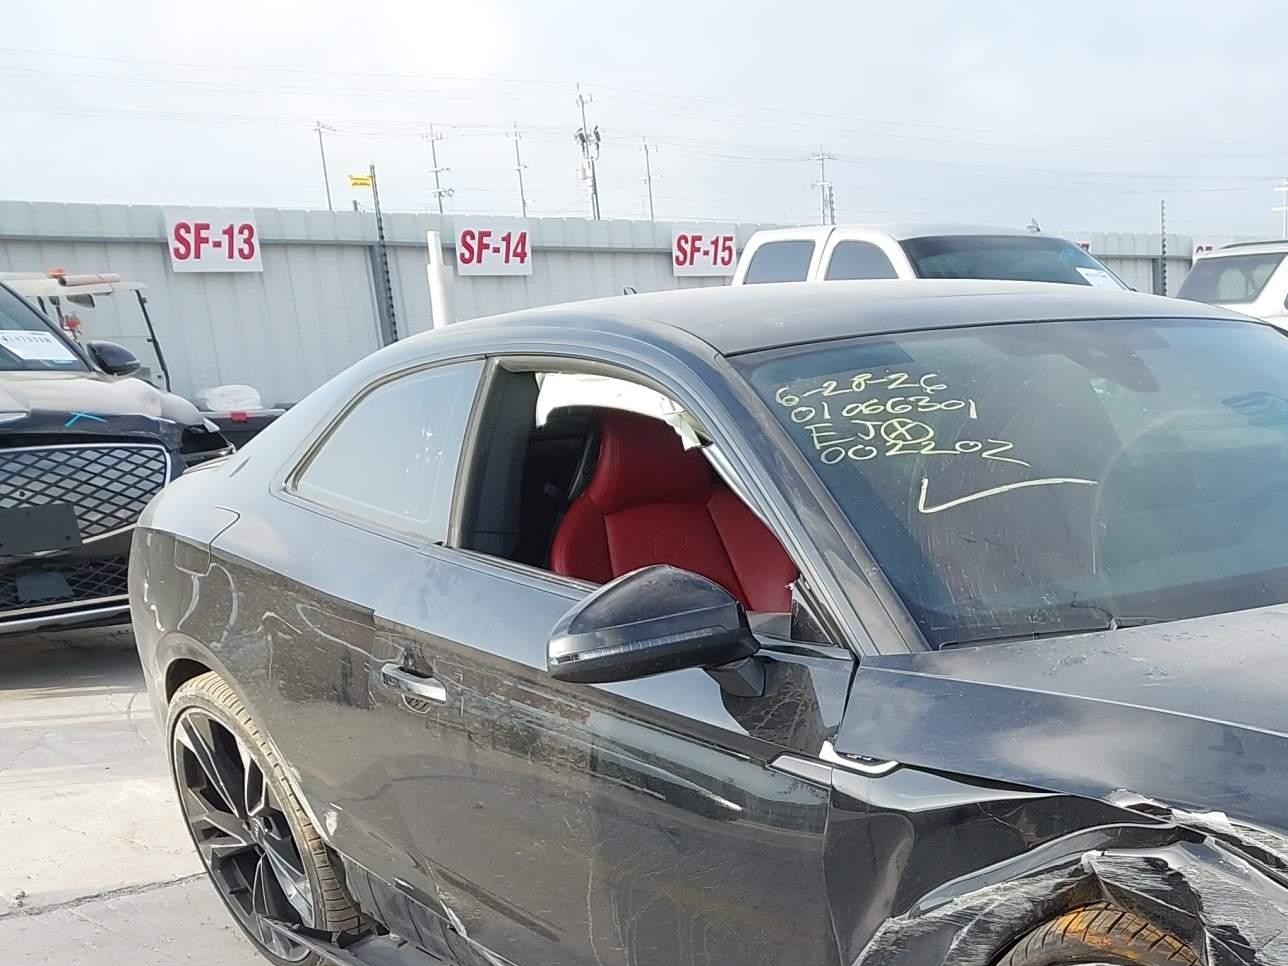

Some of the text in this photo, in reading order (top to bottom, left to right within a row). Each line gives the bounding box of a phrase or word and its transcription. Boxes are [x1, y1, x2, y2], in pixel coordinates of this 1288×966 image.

[173, 222, 255, 260] SF-13
[459, 230, 528, 264] SF-14
[674, 234, 734, 266] SF-15
[775, 372, 948, 407] 6-28-26
